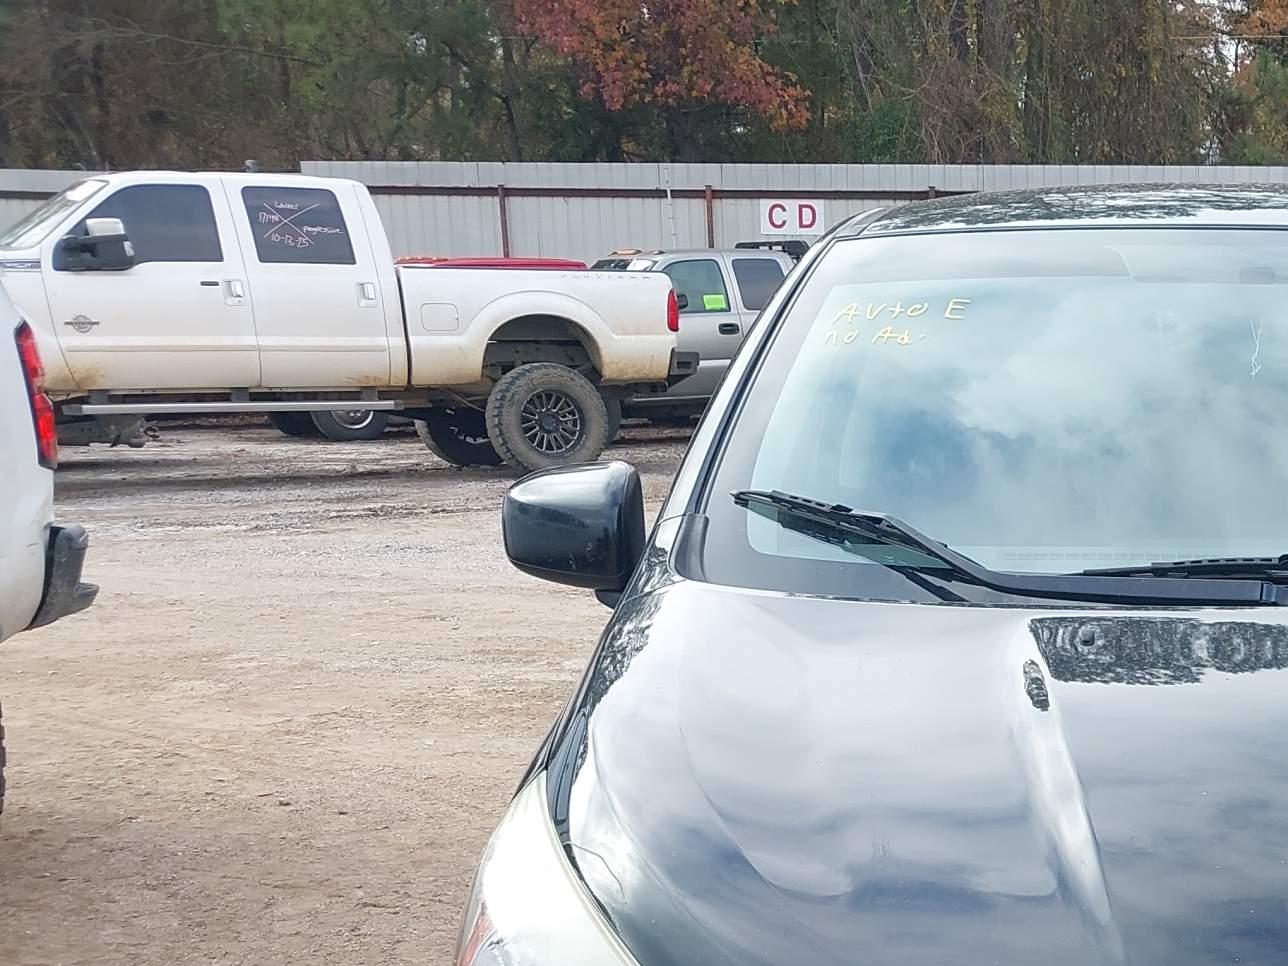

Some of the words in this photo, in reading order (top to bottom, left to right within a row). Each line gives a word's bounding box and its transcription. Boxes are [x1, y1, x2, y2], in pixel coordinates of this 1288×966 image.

[768, 203, 787, 229] C
[798, 204, 817, 229] D
[943, 298, 971, 320] E
